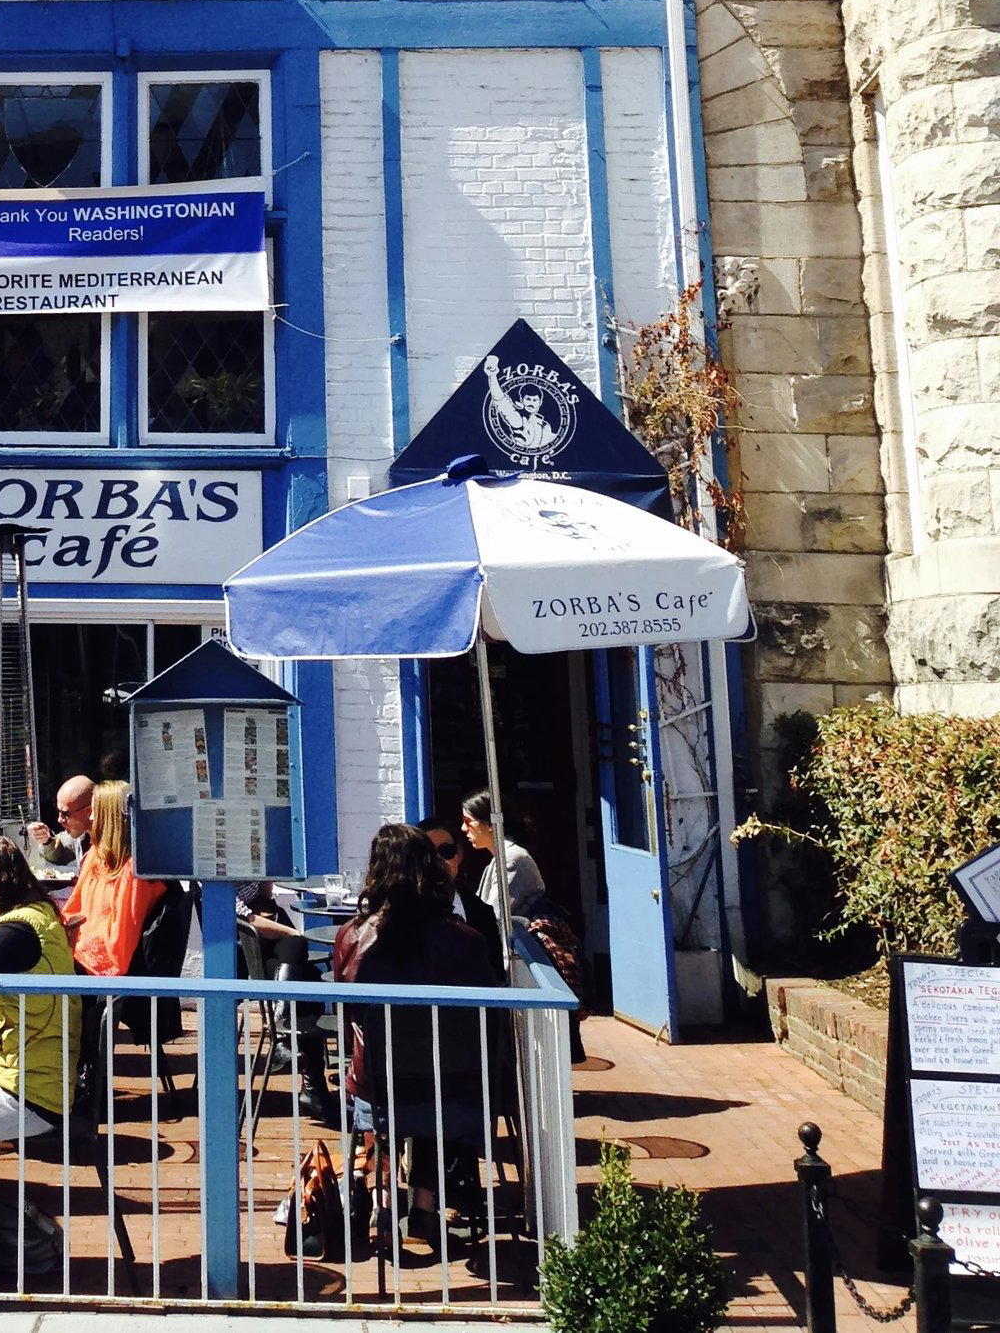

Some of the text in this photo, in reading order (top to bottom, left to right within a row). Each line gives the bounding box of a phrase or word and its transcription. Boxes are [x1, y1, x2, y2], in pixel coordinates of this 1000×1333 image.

[35, 209, 68, 222] You
[73, 202, 235, 221] WASHINGTONIAN
[68, 227, 144, 242] Readers!
[59, 270, 223, 288] MEDITERRANEAN
[503, 363, 580, 405] ZORBA'S
[20, 523, 159, 579] café
[533, 592, 641, 618] ZORBA'S
[579, 618, 681, 638] 202.387.8555
[947, 968, 990, 978] SPECIAL
[923, 1147, 953, 1156] Served
[948, 1207, 981, 1218] TRY
[957, 1236, 989, 1247] olive
